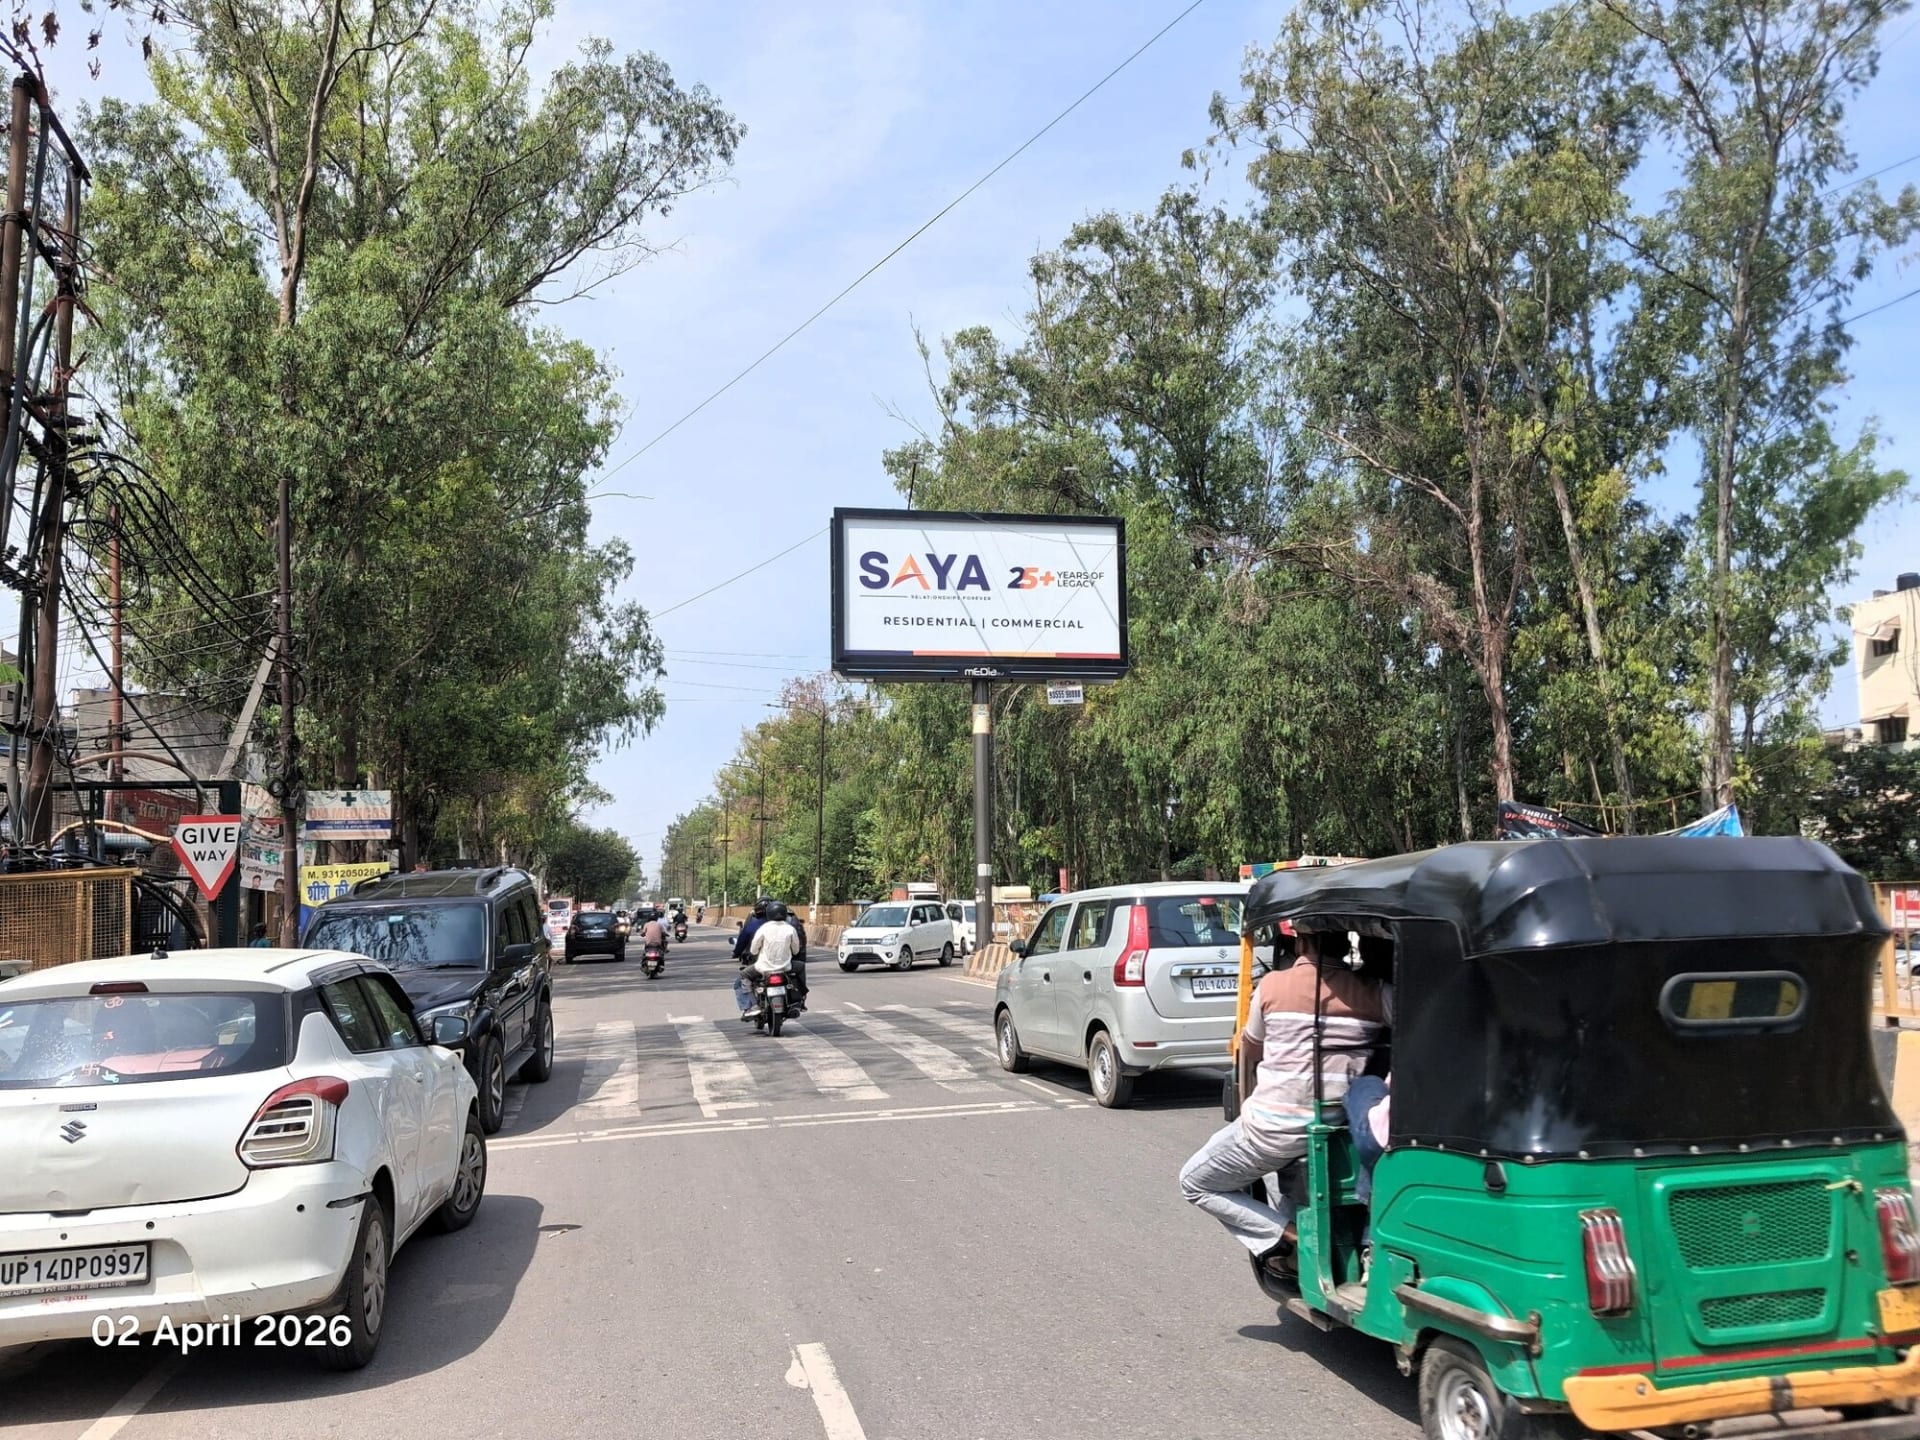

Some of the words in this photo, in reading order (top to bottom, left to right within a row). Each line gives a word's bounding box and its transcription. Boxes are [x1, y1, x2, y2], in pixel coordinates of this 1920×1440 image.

[859, 551, 991, 592] SAYA
[1007, 566, 1055, 590] 25+
[1057, 571, 1089, 580] YEARS
[1091, 572, 1105, 580] OF
[1057, 580, 1095, 588] LEGACY
[883, 616, 977, 627] RESIDENTIAL
[991, 618, 1085, 629] COMMERCIAL
[1522, 808, 1553, 821] THRILL
[182, 827, 236, 844] GIVE
[193, 850, 228, 862] WAY
[308, 871, 320, 879] M.
[1, 1252, 145, 1284] UP14DP0997
